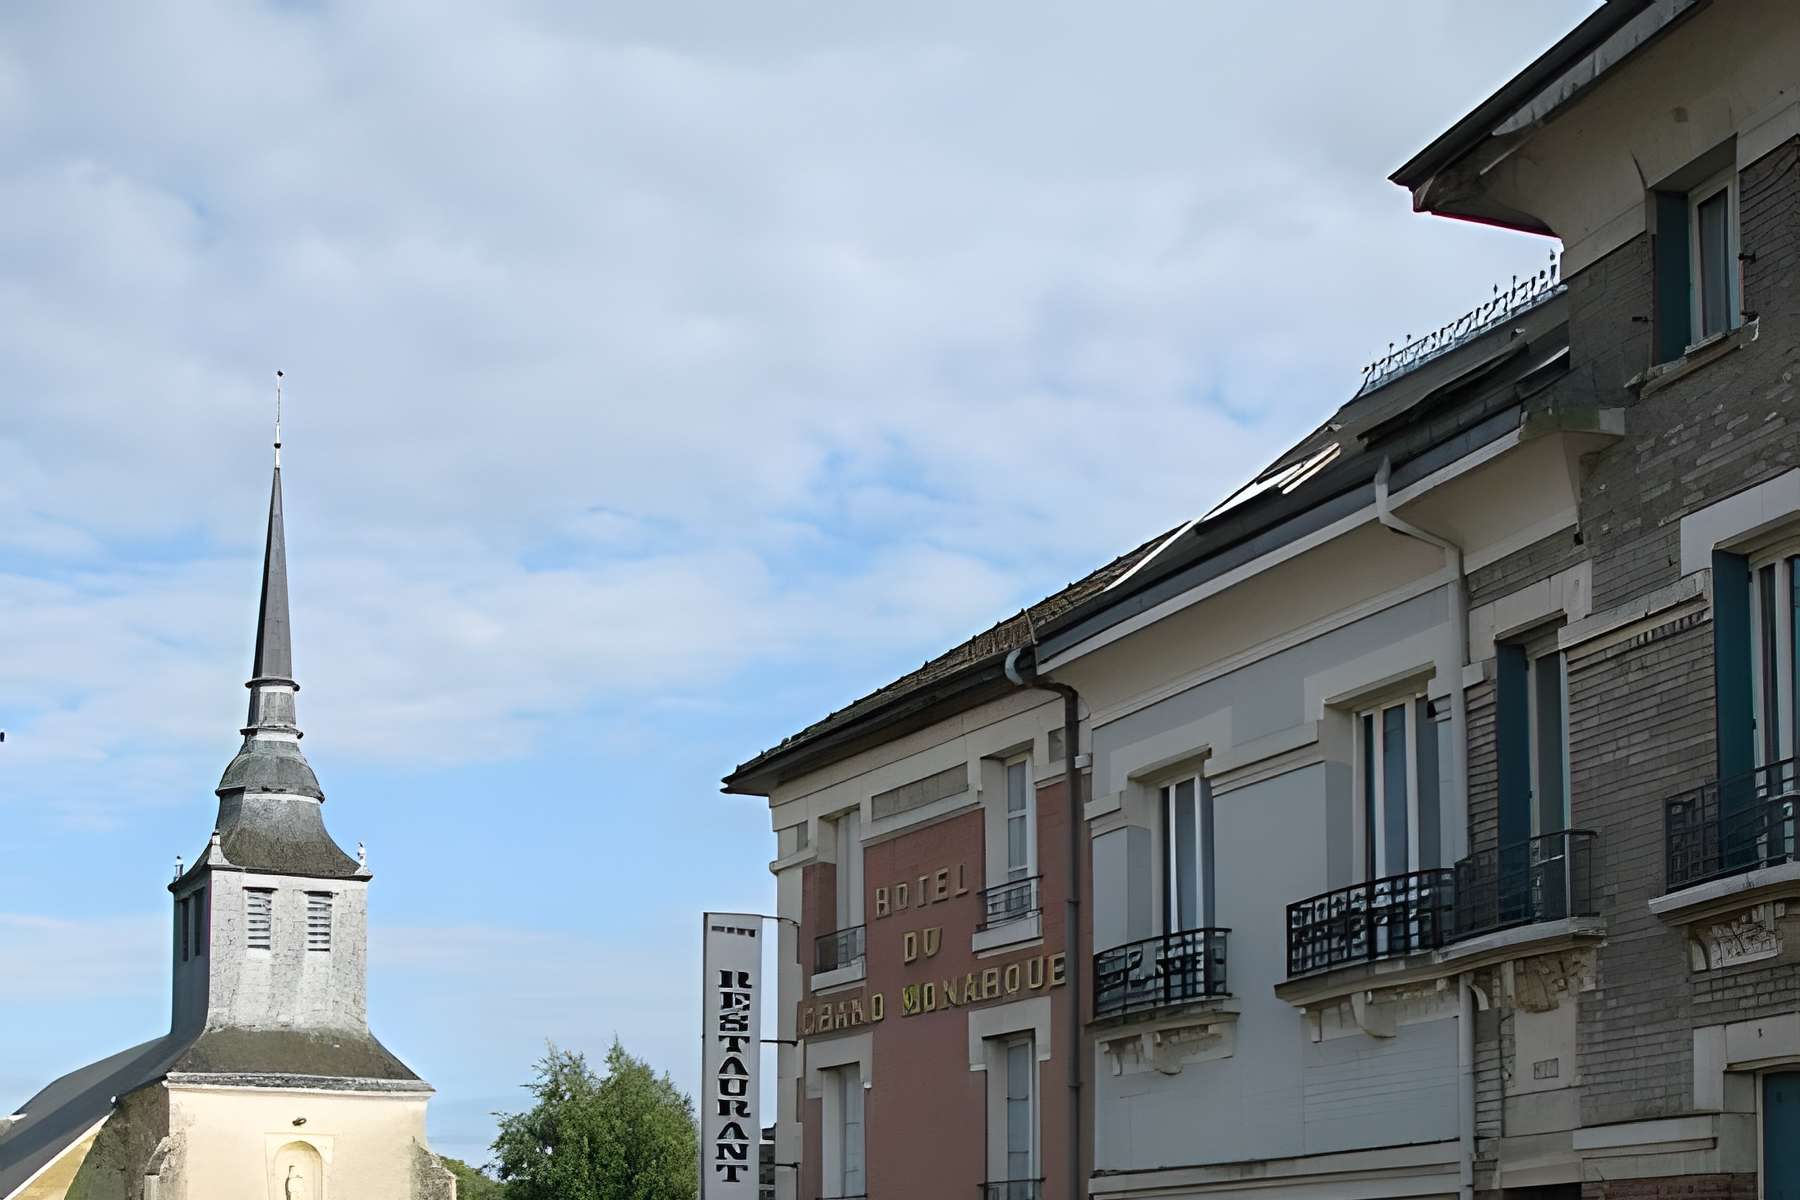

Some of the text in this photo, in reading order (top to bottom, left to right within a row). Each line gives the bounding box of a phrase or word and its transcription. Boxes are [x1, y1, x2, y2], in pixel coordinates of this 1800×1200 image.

[875, 863, 969, 920] HOTEL
[903, 927, 943, 966] DU
[715, 969, 753, 1183] RESTAURANT
